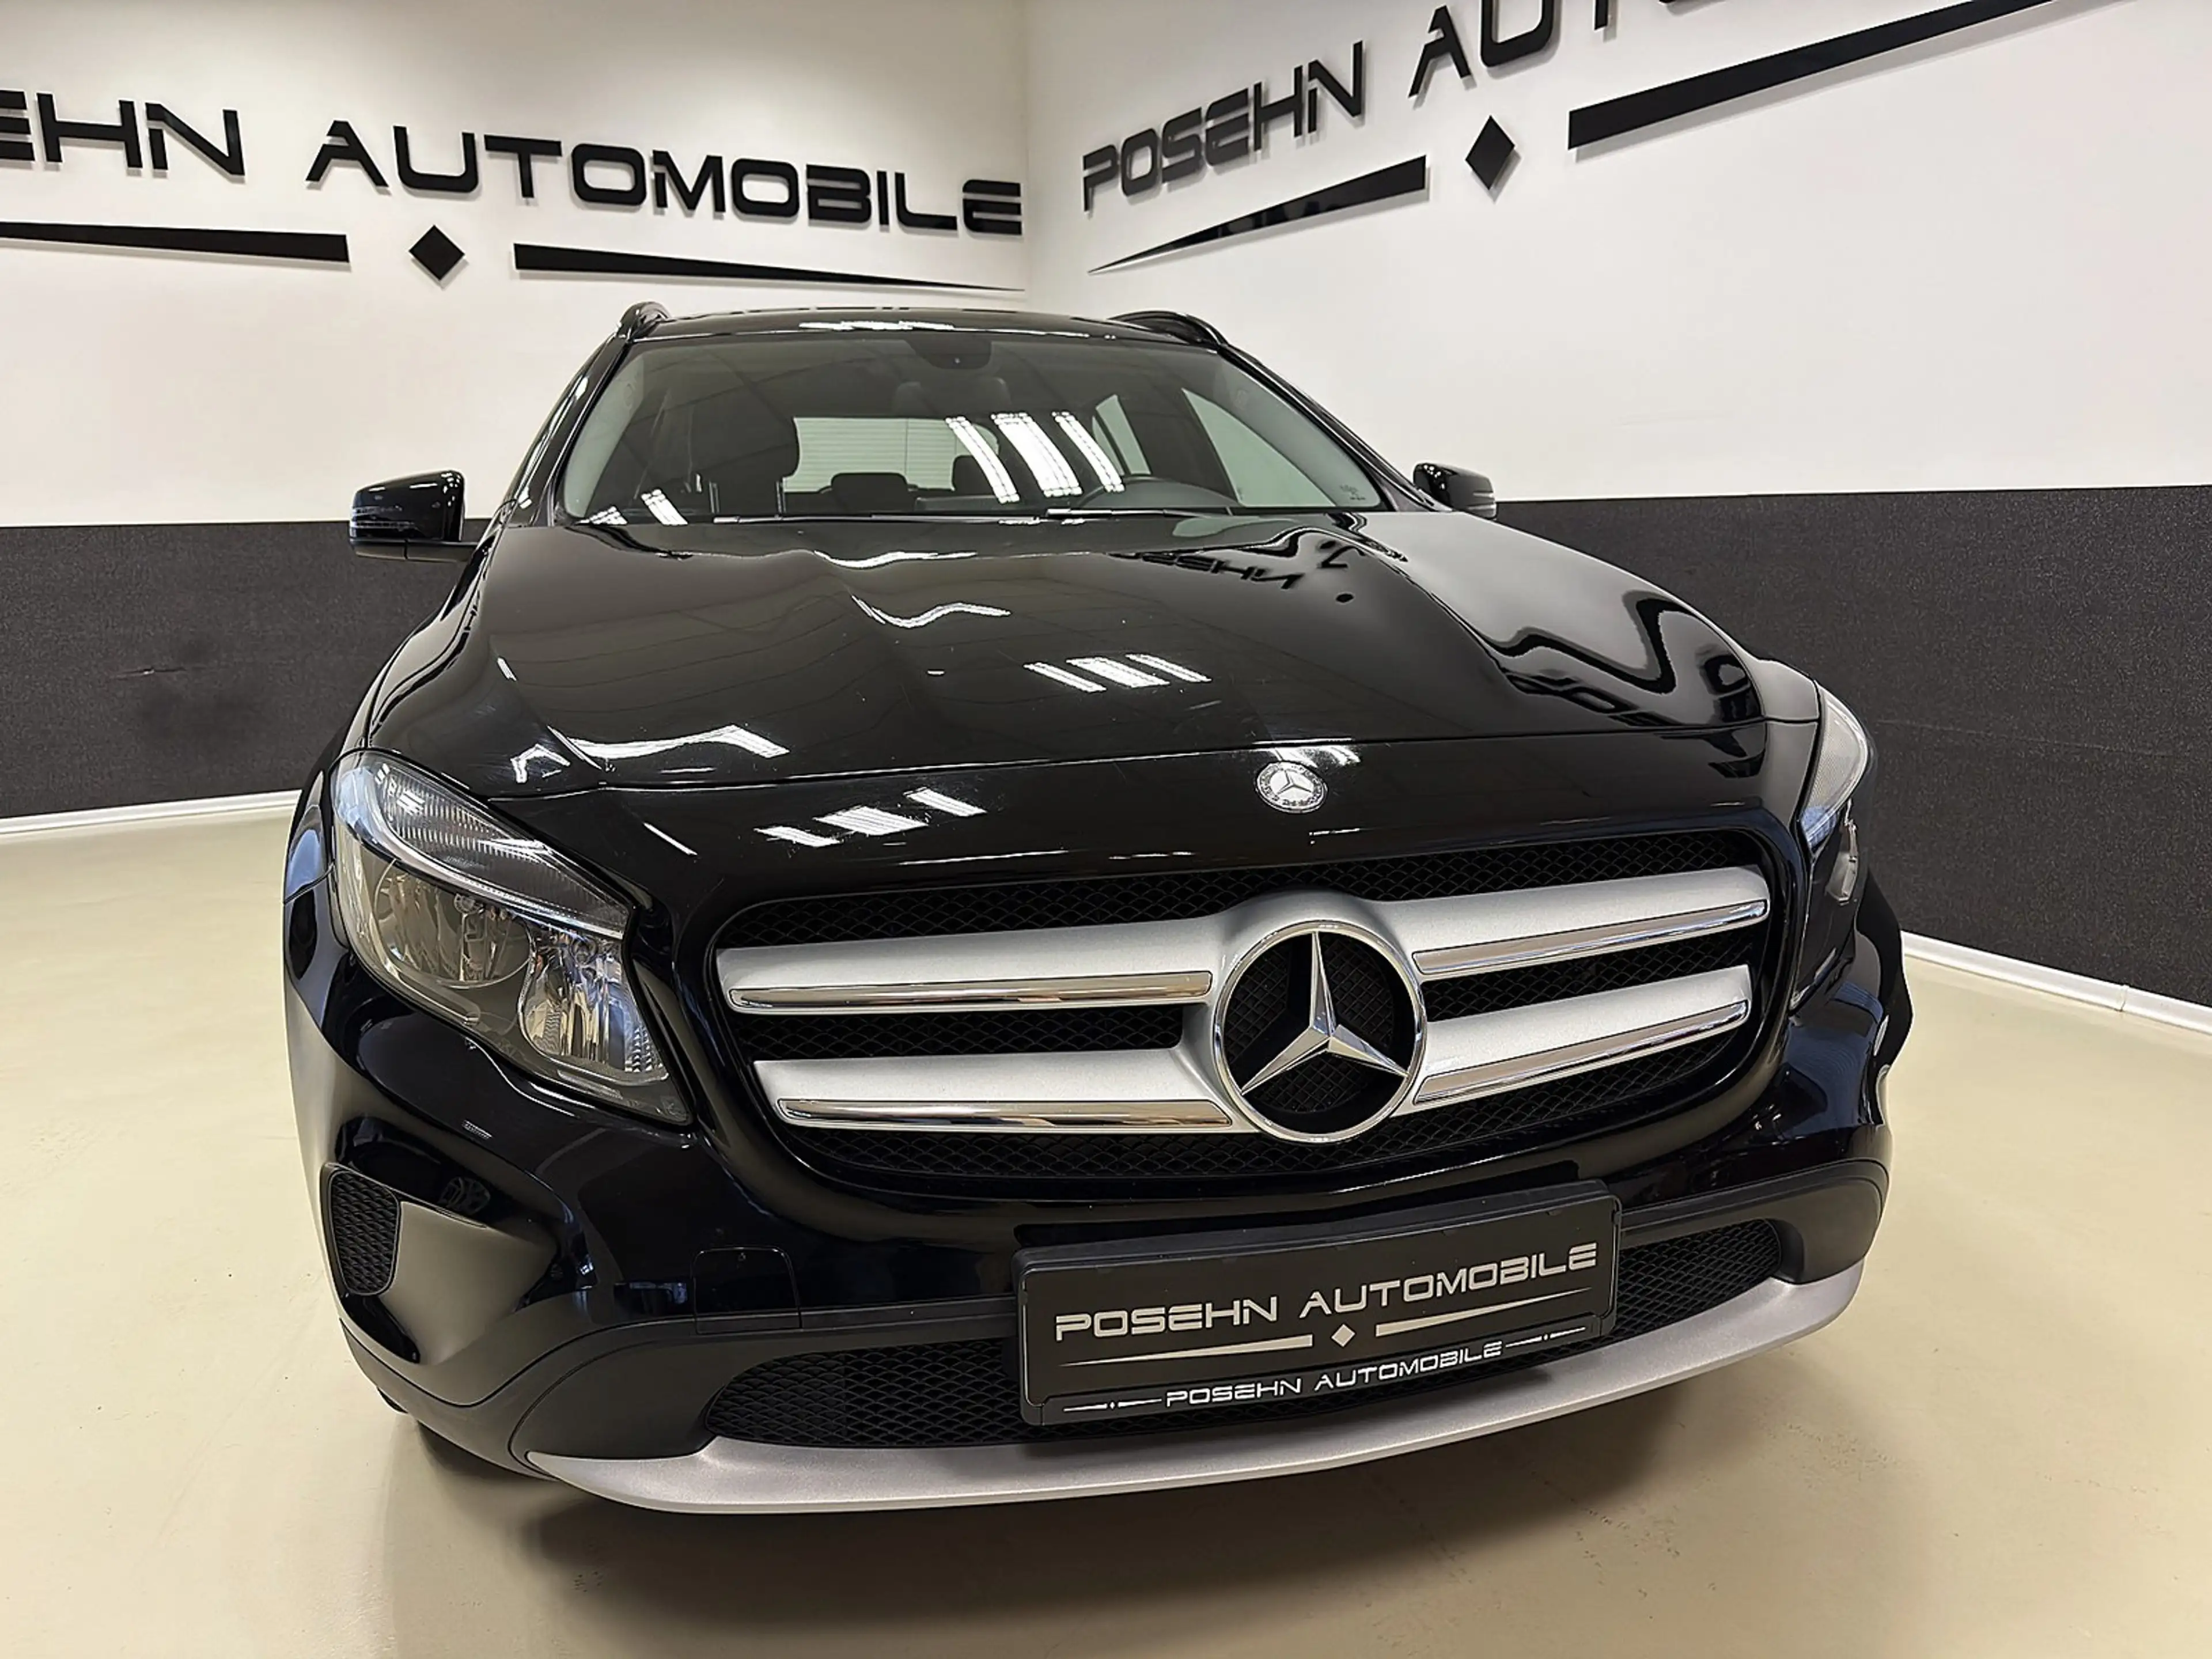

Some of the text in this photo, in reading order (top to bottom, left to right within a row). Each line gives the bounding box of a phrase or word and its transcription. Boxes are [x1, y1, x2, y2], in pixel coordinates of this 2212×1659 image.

[1083, 0, 1677, 211] POSEHN AU
[306, 120, 1022, 235] AUTOMOBILE
[1056, 1243, 1597, 1341] POSEHN AUTOMOBILE
[1166, 1340, 1502, 1407] POSEHN AUTOMOBILE
